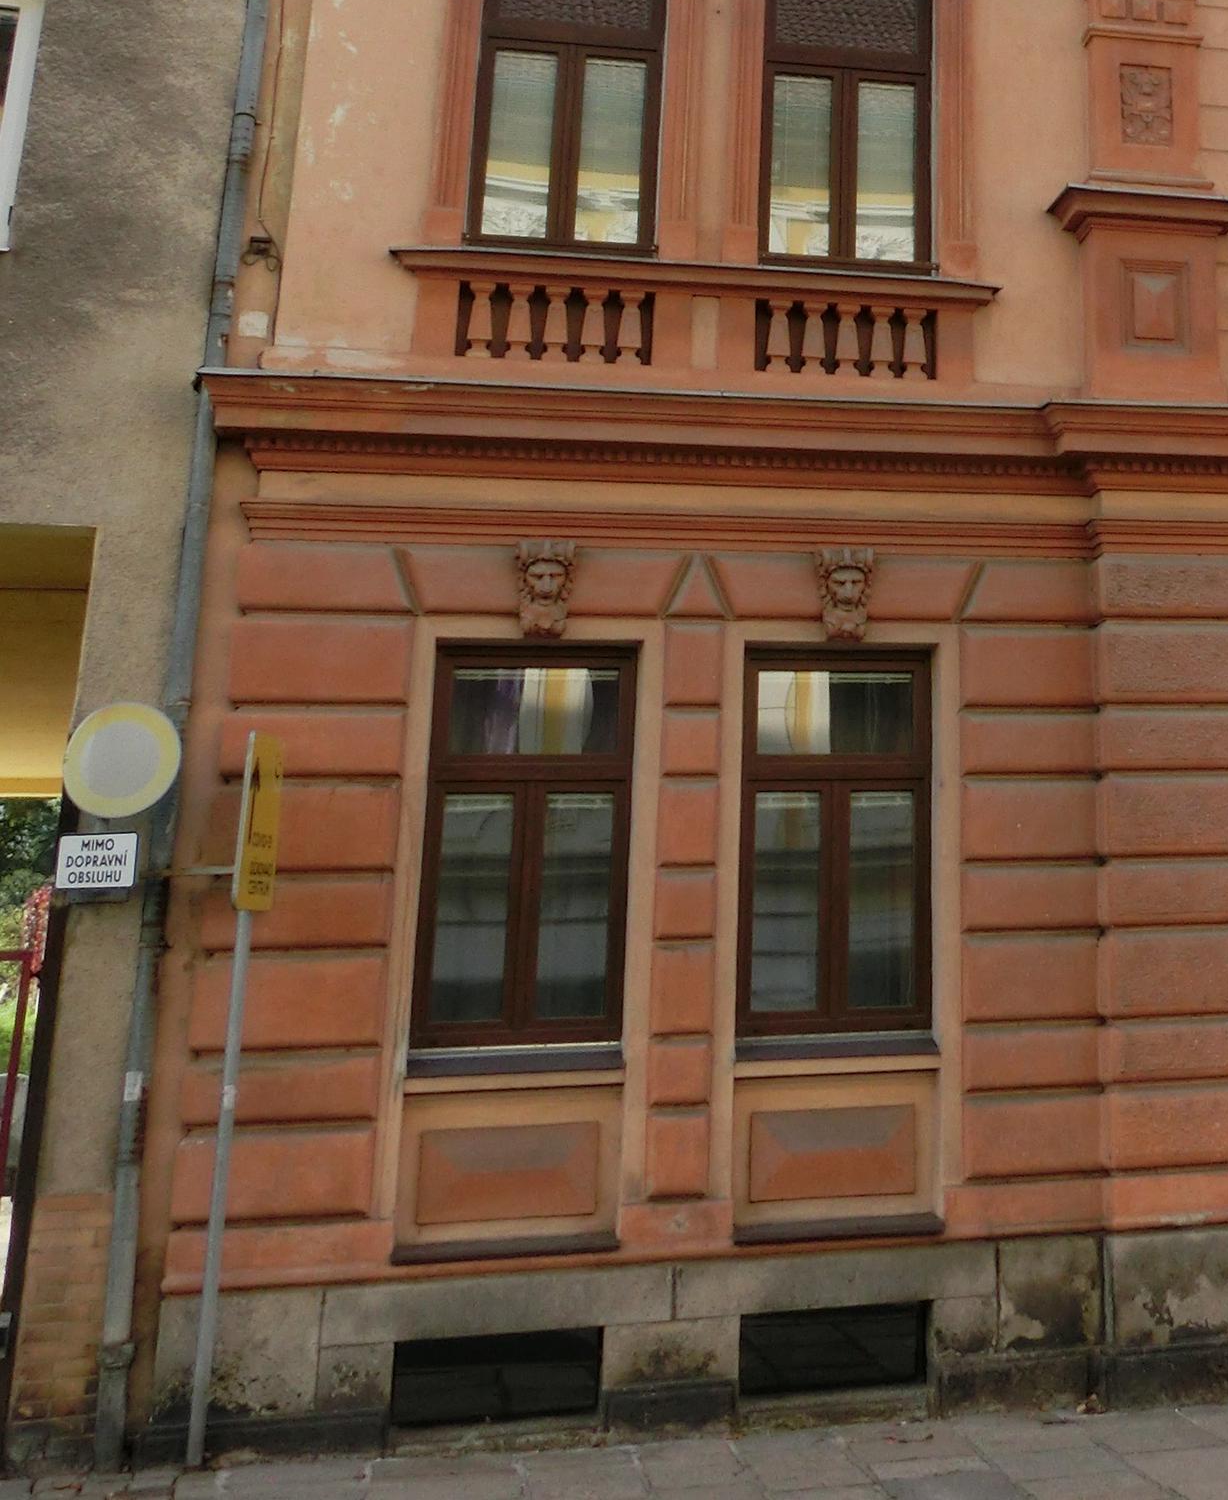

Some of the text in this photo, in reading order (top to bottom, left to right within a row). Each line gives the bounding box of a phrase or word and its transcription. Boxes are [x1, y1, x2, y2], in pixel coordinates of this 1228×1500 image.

[81, 838, 115, 851] MIMO
[65, 849, 128, 868] DOPRAVNÍ
[67, 870, 122, 884] OBSLUHU
